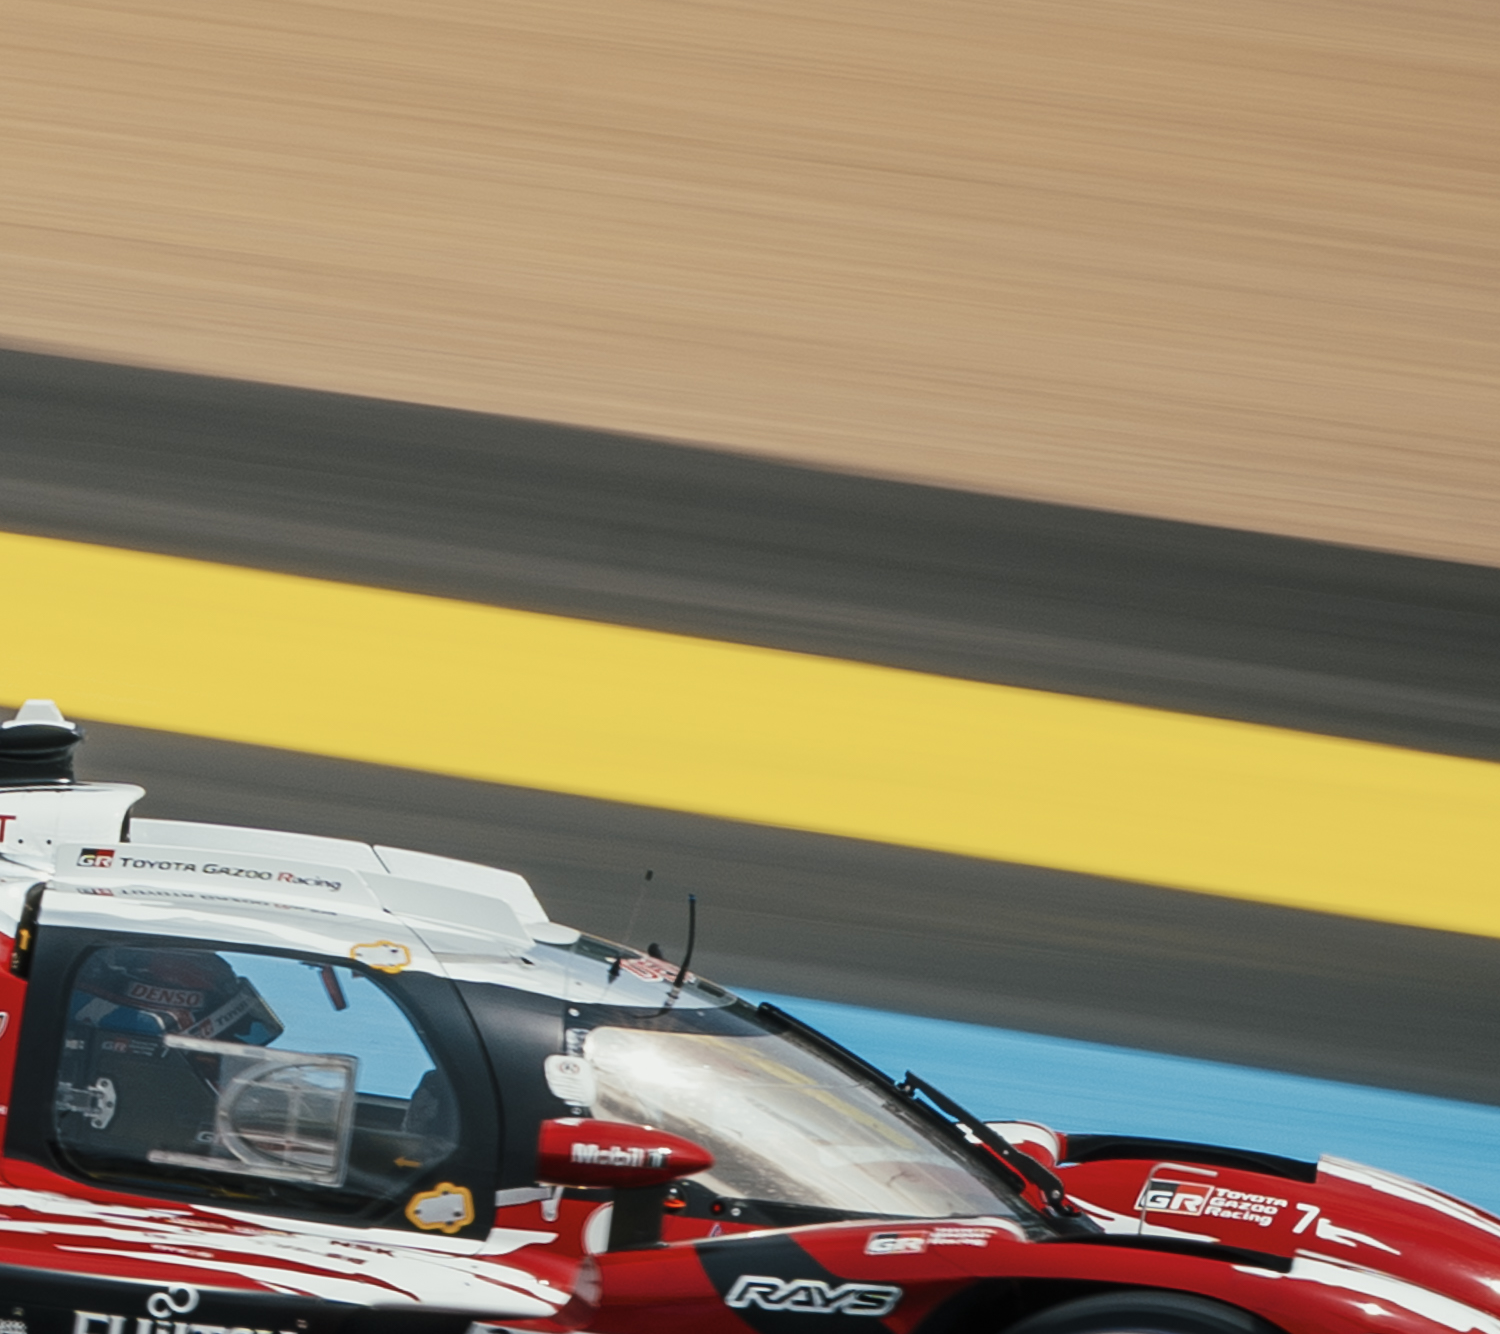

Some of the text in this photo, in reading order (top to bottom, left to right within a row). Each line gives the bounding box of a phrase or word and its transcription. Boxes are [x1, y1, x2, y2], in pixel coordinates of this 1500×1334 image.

[79, 853, 342, 892] GR TOYOTA GAZOO Racing
[130, 982, 201, 1006] DENSO
[571, 1142, 645, 1167] Mobil
[1139, 1190, 1204, 1213] GR
[1209, 1197, 1279, 1215] GAZOO
[1214, 1187, 1288, 1208] TOYOTA
[1204, 1206, 1273, 1227] Racing
[1292, 1202, 1321, 1234] 7
[866, 1237, 925, 1253] GR
[725, 1275, 903, 1316] RAYS
